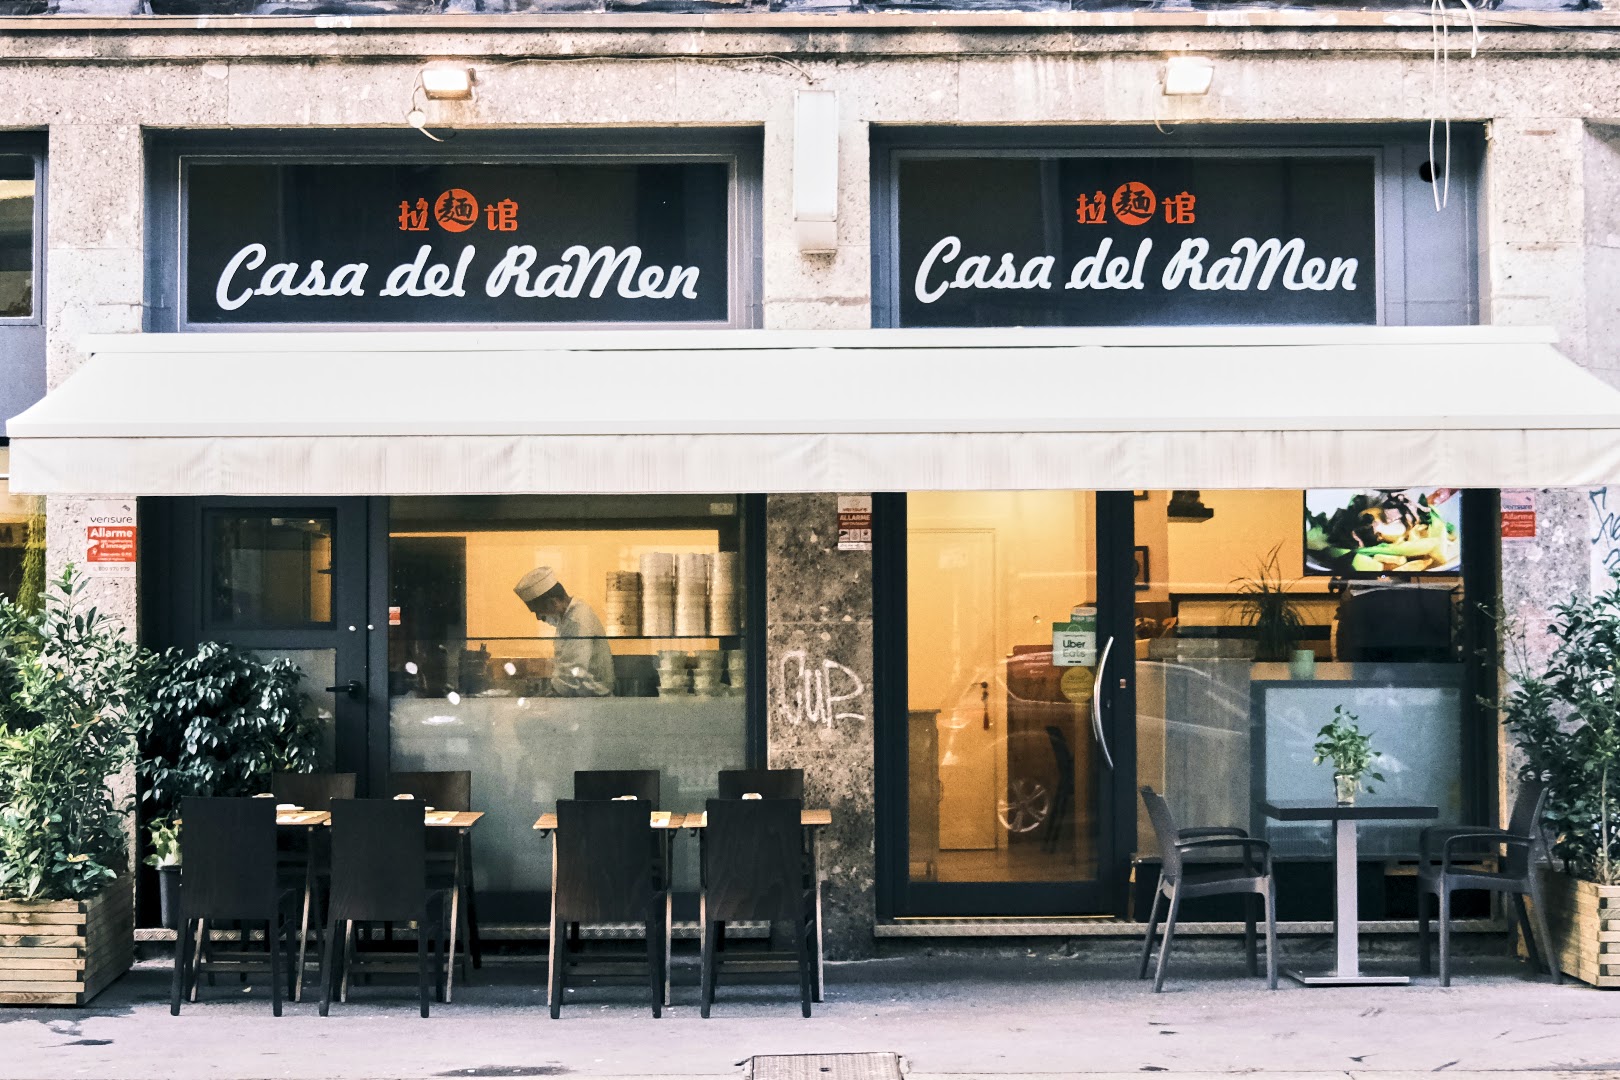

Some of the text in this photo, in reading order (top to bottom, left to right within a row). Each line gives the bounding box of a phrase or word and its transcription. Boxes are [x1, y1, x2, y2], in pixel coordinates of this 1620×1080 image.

[915, 236, 1358, 303] Casa del RaMen
[216, 243, 700, 310] Casa del RaMen
[90, 516, 133, 524] verisure
[90, 527, 133, 538] Allarme
[1062, 639, 1086, 649] Uber
[1062, 649, 1086, 658] Eats
